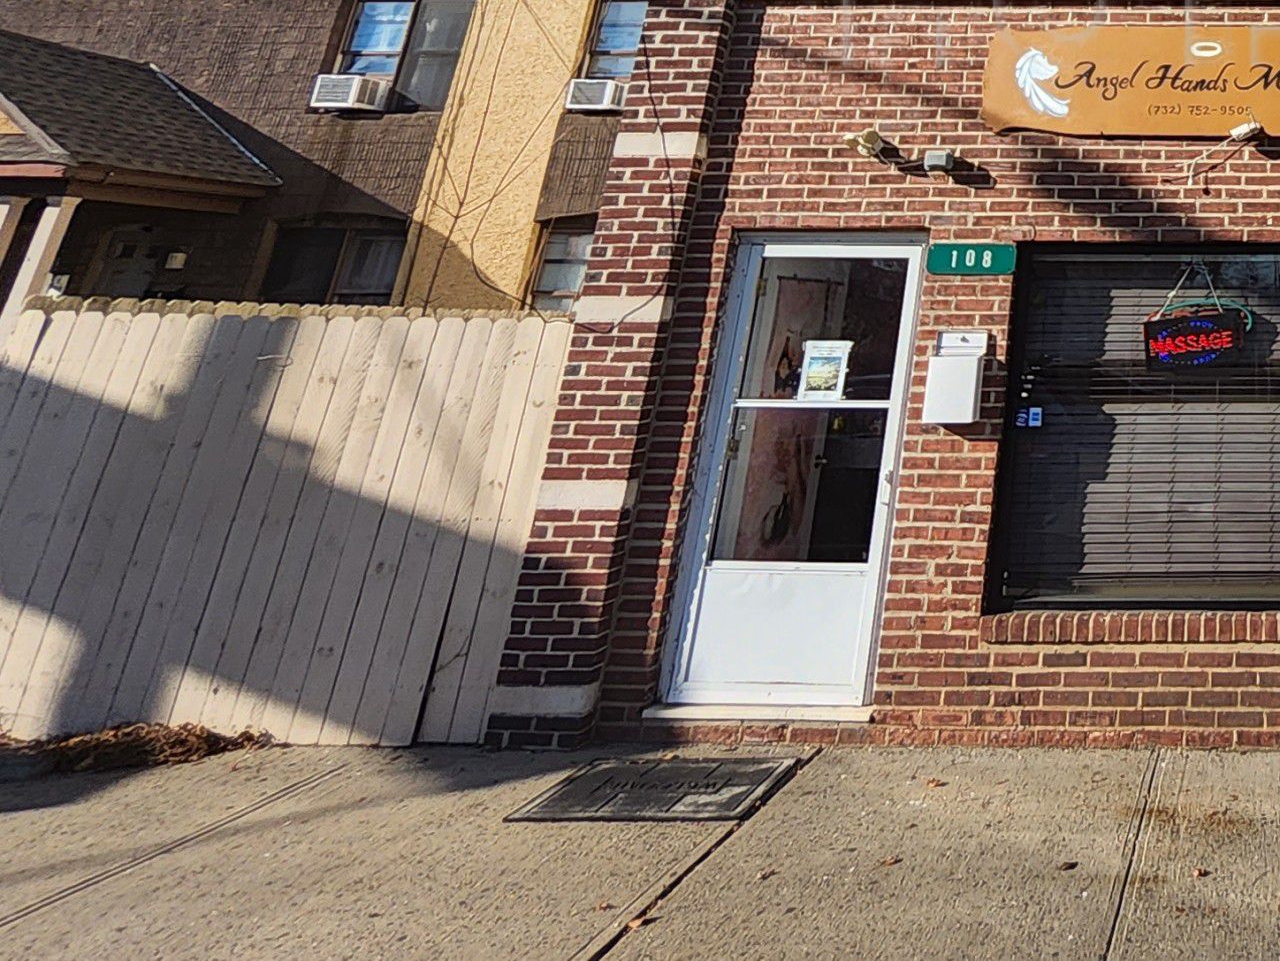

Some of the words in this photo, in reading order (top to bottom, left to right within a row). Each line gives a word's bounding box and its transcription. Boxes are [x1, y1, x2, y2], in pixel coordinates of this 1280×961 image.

[1055, 60, 1150, 101] Angel
[1145, 62, 1236, 93] Hands
[1148, 103, 1181, 116] (732)
[951, 249, 992, 269] 108
[1149, 331, 1233, 357] MASSAGE
